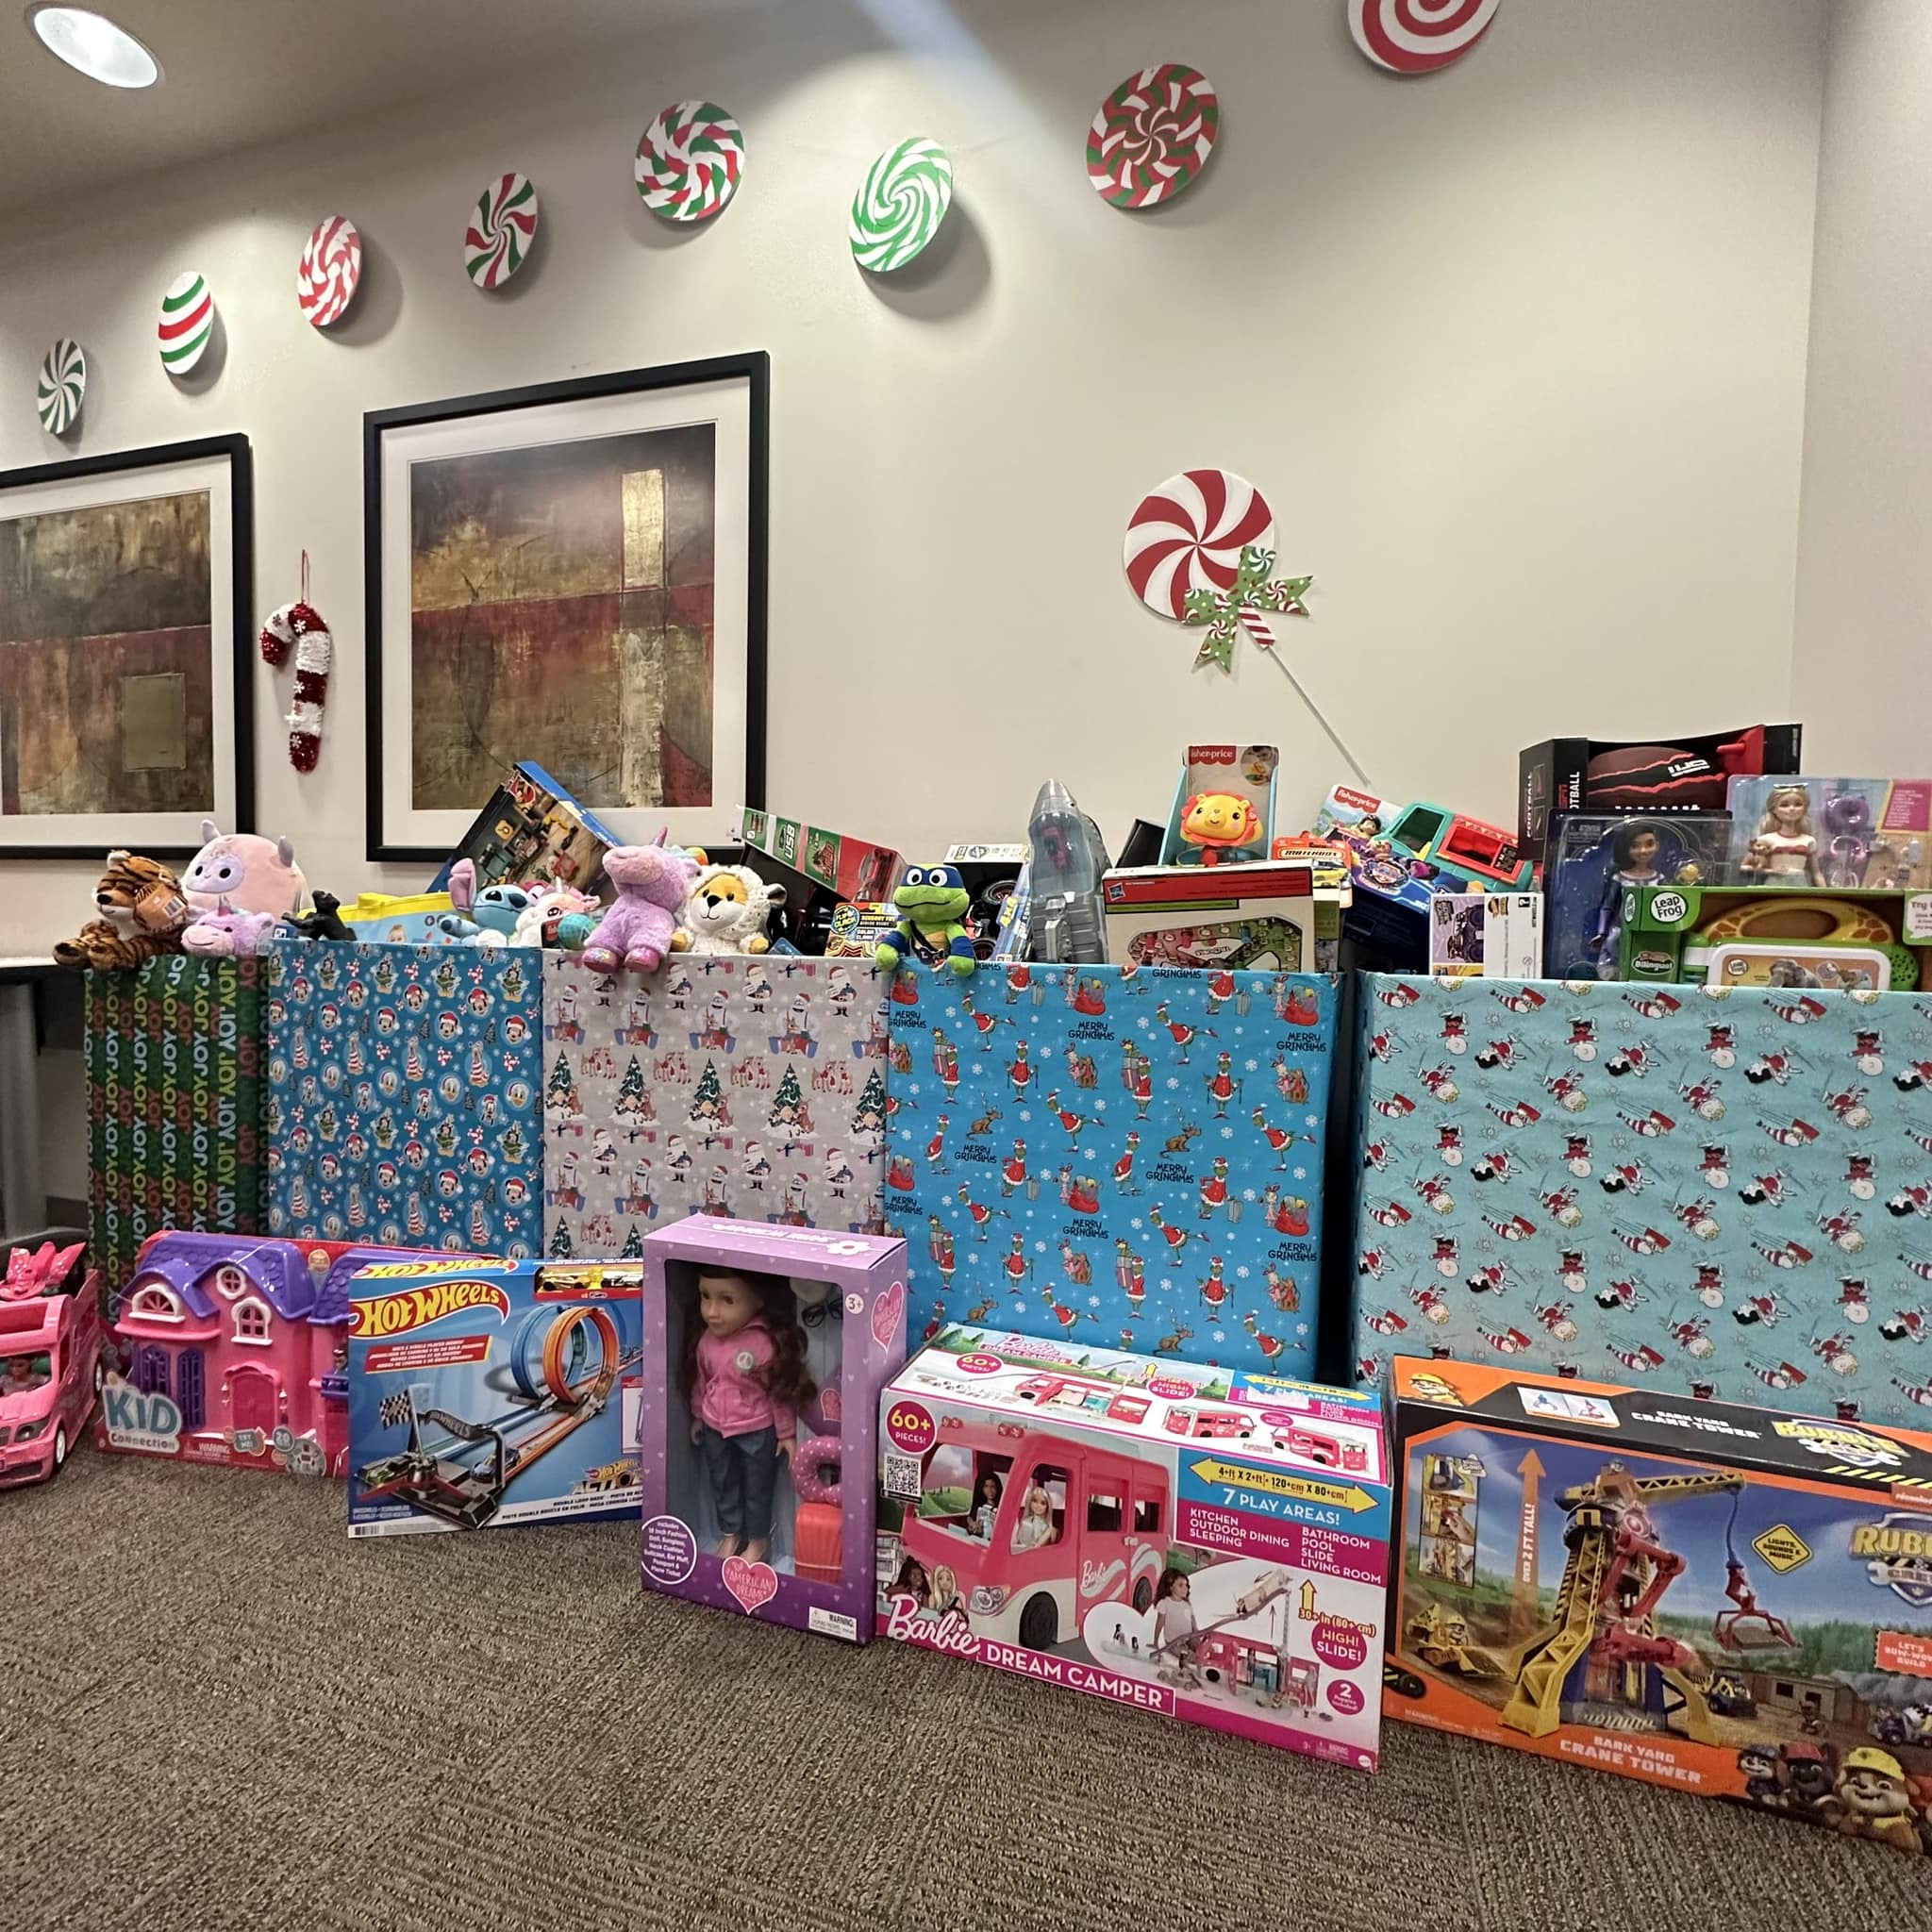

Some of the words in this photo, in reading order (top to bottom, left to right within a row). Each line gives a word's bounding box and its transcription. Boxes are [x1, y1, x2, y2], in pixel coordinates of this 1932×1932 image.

[1190, 748, 1233, 760] isher-price
[784, 824, 796, 859] USB
[1655, 896, 1680, 909] Leap
[1657, 905, 1682, 919] Frog
[218, 961, 236, 1008] JOY
[106, 981, 119, 1025] JOY
[134, 982, 148, 1027] JOY
[162, 984, 177, 1029] JOY
[193, 985, 209, 1031] JOY
[895, 1010, 921, 1020] MERRY
[218, 1007, 236, 1052] JOY
[1068, 1028, 1115, 1041] GRINCHMAS
[1078, 1021, 1108, 1031] MERRY
[1288, 1032, 1321, 1042] MERRY
[106, 1025, 119, 1070] JOY
[134, 1026, 148, 1072] JOY
[162, 1029, 177, 1074] JOY
[193, 1031, 209, 1077] JOY
[1276, 1041, 1326, 1052] GRINCHMAS
[218, 1052, 236, 1097] JOY
[106, 1069, 119, 1113] JOY
[134, 1071, 148, 1115] JOY
[162, 1074, 177, 1118] JOY
[193, 1075, 209, 1121] JOY
[218, 1096, 236, 1141] JOY
[106, 1113, 119, 1158] JOY
[134, 1115, 148, 1160] JOY
[162, 1118, 177, 1163] JOY
[193, 1121, 209, 1166] JOY
[963, 1144, 991, 1155] MERRY
[218, 1141, 236, 1186] JOY
[955, 1152, 996, 1163] GRINCHMAS
[1156, 1163, 1187, 1174] MERRY
[106, 1157, 119, 1200] JOY
[134, 1158, 148, 1204] JOY
[162, 1162, 177, 1208] JOY
[193, 1164, 209, 1210] JOY
[1146, 1171, 1194, 1183] GRINCHMAS
[218, 1185, 236, 1230] JOY
[891, 1195, 917, 1206] MERRY
[106, 1200, 119, 1243] JOY
[1062, 1226, 1108, 1240] GRINCHMAS
[1073, 1219, 1102, 1229] MERRY
[1268, 1250, 1318, 1261] GRINCHMAS
[1279, 1241, 1311, 1253] MERRY
[106, 1242, 119, 1285] JOY
[367, 1265, 425, 1278] HOT
[421, 1259, 510, 1274] WHEELS
[355, 1295, 412, 1337] HOT
[407, 1281, 500, 1327] WHEELS
[848, 1298, 862, 1309] 3+
[962, 1356, 998, 1368] 60+
[1152, 1386, 1190, 1397] SLIDE!
[105, 1388, 178, 1436] KID
[891, 1409, 931, 1432] 60+
[1630, 1412, 1691, 1431] CRANE
[1692, 1421, 1760, 1440] TOWER
[110, 1433, 179, 1451] Connection
[276, 1432, 290, 1443] 20
[895, 1430, 926, 1445] PIECES!
[1191, 1507, 1239, 1525] KITCHEN
[1223, 1488, 1236, 1505] 7
[1239, 1494, 1279, 1513] PLAY
[1283, 1504, 1341, 1525] AREAS!
[1523, 1504, 1536, 1528] TALL!
[1190, 1518, 1247, 1540] OUTDOOR
[1249, 1531, 1290, 1548] DINING
[1190, 1528, 1242, 1547] SLEEPING
[1302, 1526, 1371, 1550] BATHROOM
[1302, 1538, 1336, 1553] POOL
[1523, 1529, 1534, 1548] FT
[1301, 1548, 1334, 1563] SLIDE
[1522, 1548, 1533, 1561] 2
[1081, 1559, 1108, 1590] Barbie
[1301, 1557, 1341, 1575] LIVING
[1342, 1567, 1382, 1585] ROOM
[1522, 1561, 1532, 1583] OVER
[886, 1593, 982, 1656] Barbie
[1299, 1607, 1319, 1621] 30+
[1321, 1612, 1331, 1625] in
[1331, 1615, 1356, 1629] (80+
[1357, 1622, 1376, 1638] cm)
[1316, 1641, 1362, 1662] SLIDE!
[1322, 1628, 1359, 1647] HIGH!
[987, 1644, 1062, 1680] DREAM
[1067, 1667, 1163, 1708] CAMPER
[1340, 1682, 1352, 1698] 2
[1559, 1740, 1624, 1766] CRANE
[1629, 1755, 1702, 1784] TOWER
[1593, 1735, 1632, 1754] BARK
[1635, 1745, 1675, 1765] YARD
